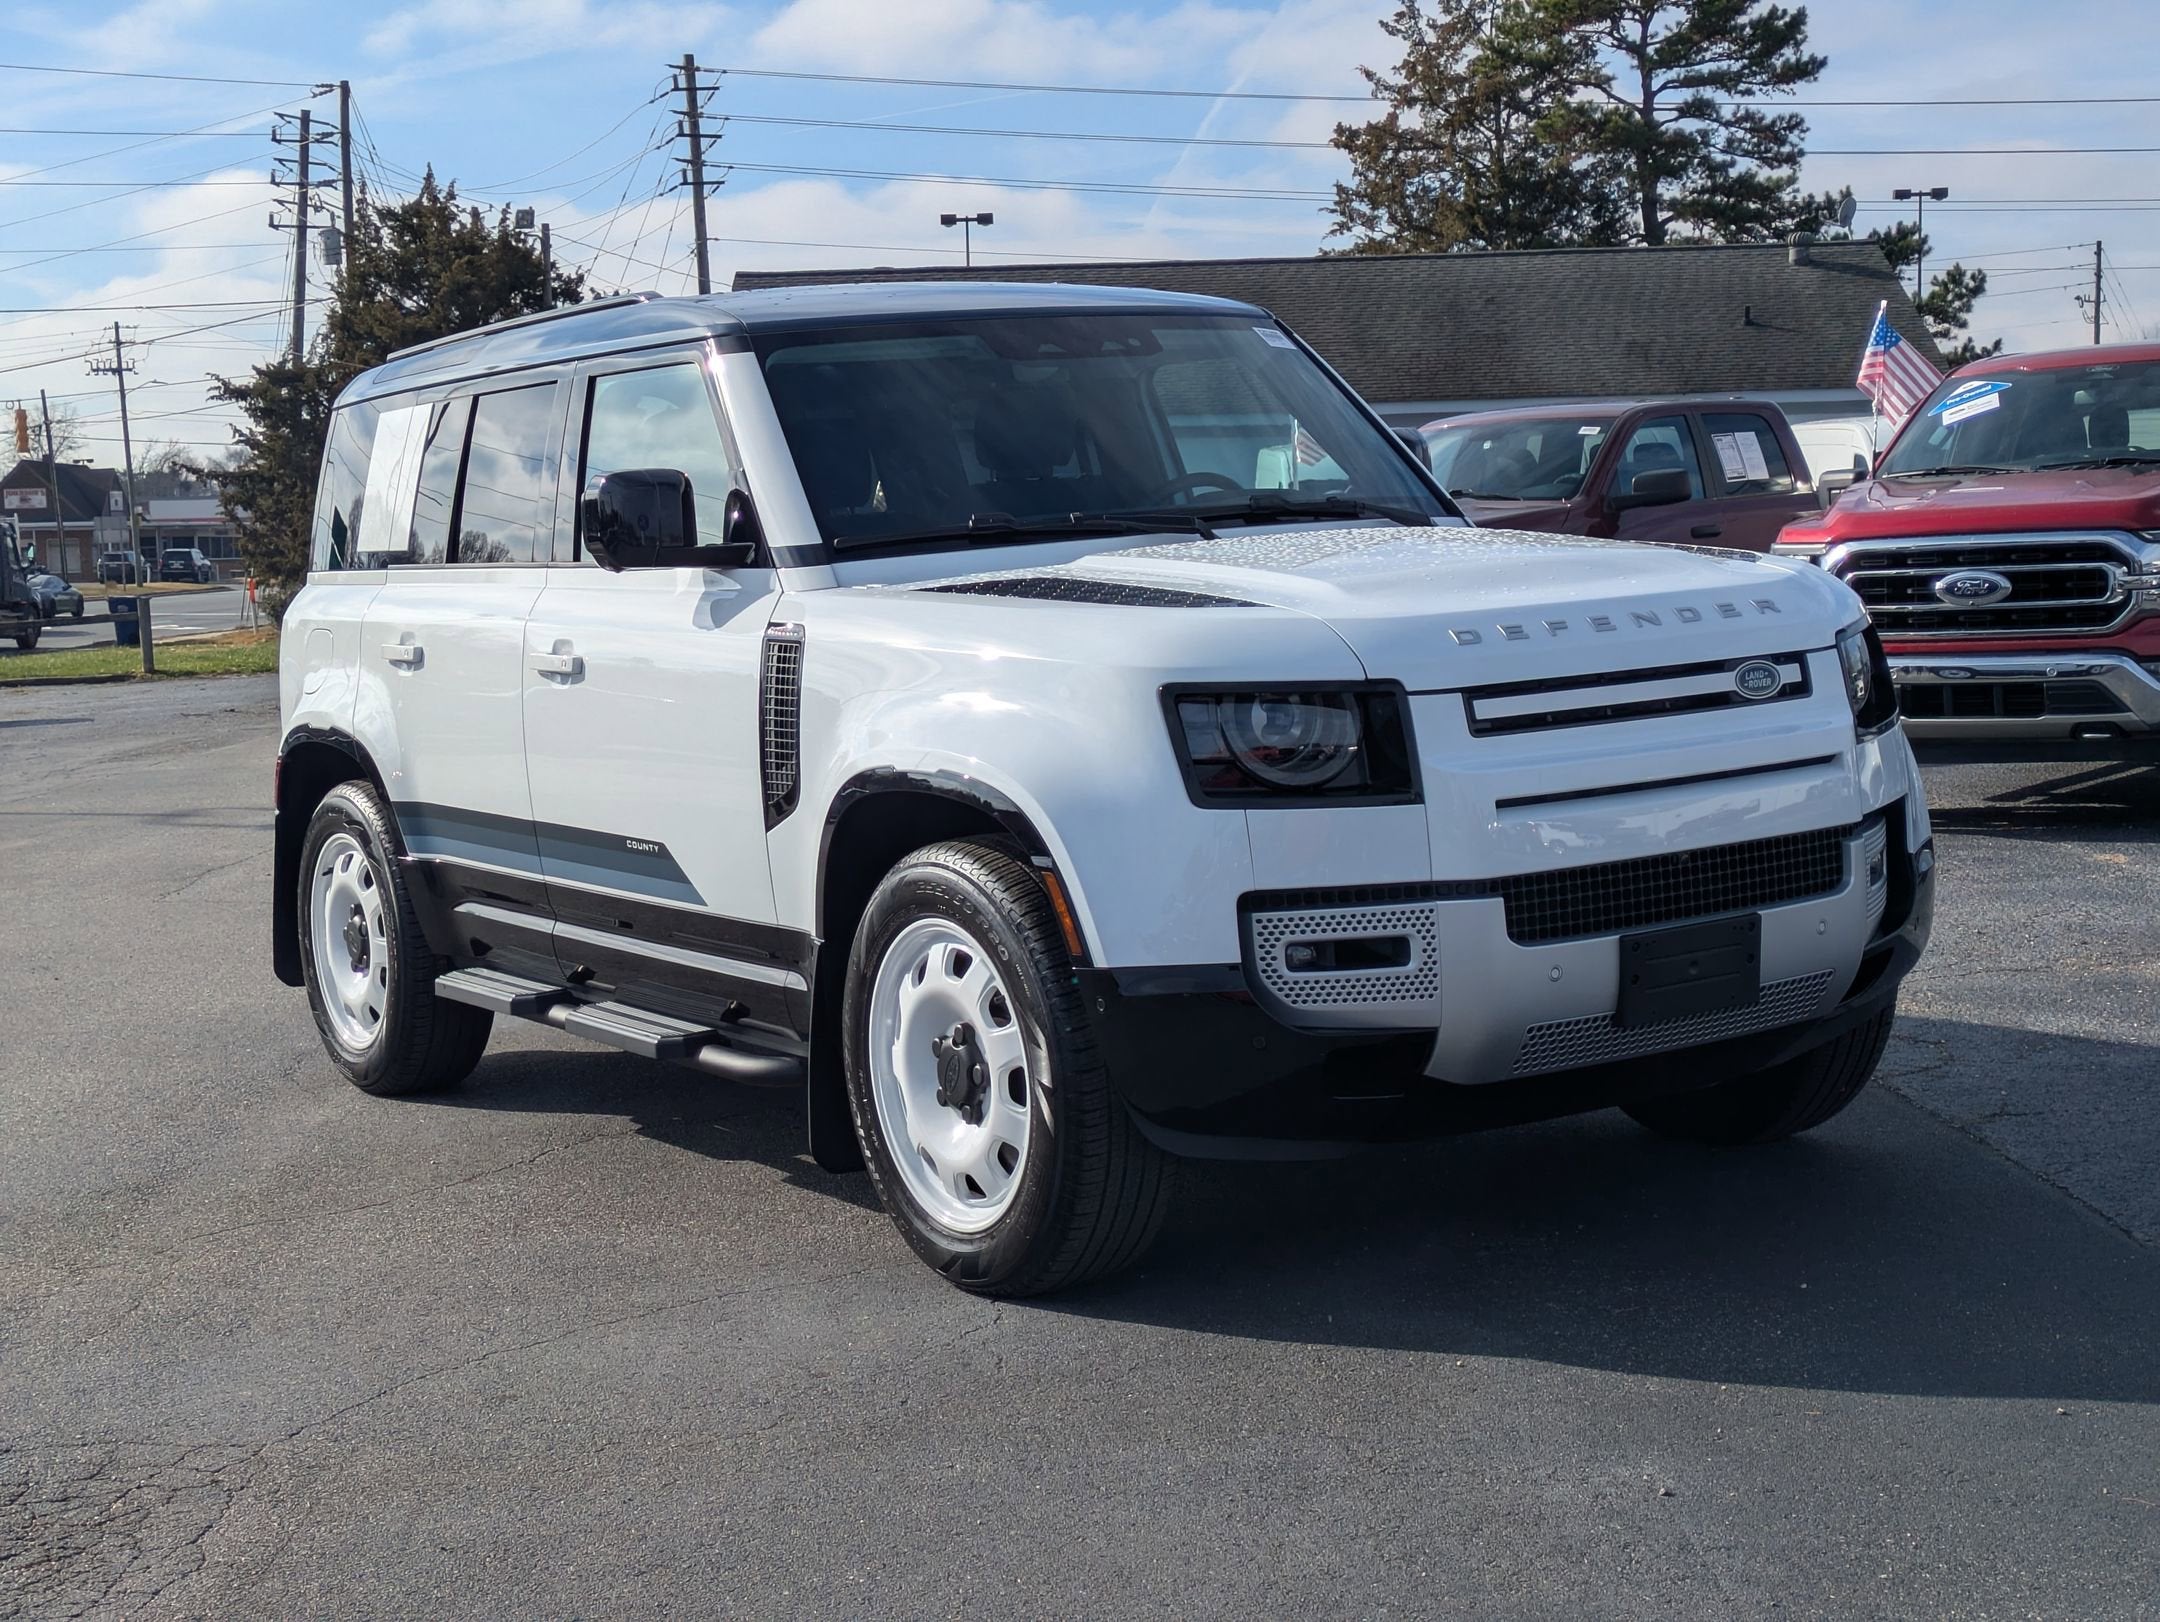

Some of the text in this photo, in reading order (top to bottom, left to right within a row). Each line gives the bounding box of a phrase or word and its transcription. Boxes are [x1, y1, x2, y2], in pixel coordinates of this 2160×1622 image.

[1946, 384, 1992, 405] Pre-Owned
[1953, 577, 1990, 596] Ford
[1448, 598, 1782, 646] DEFENDER
[626, 839, 659, 853] COUNTY
